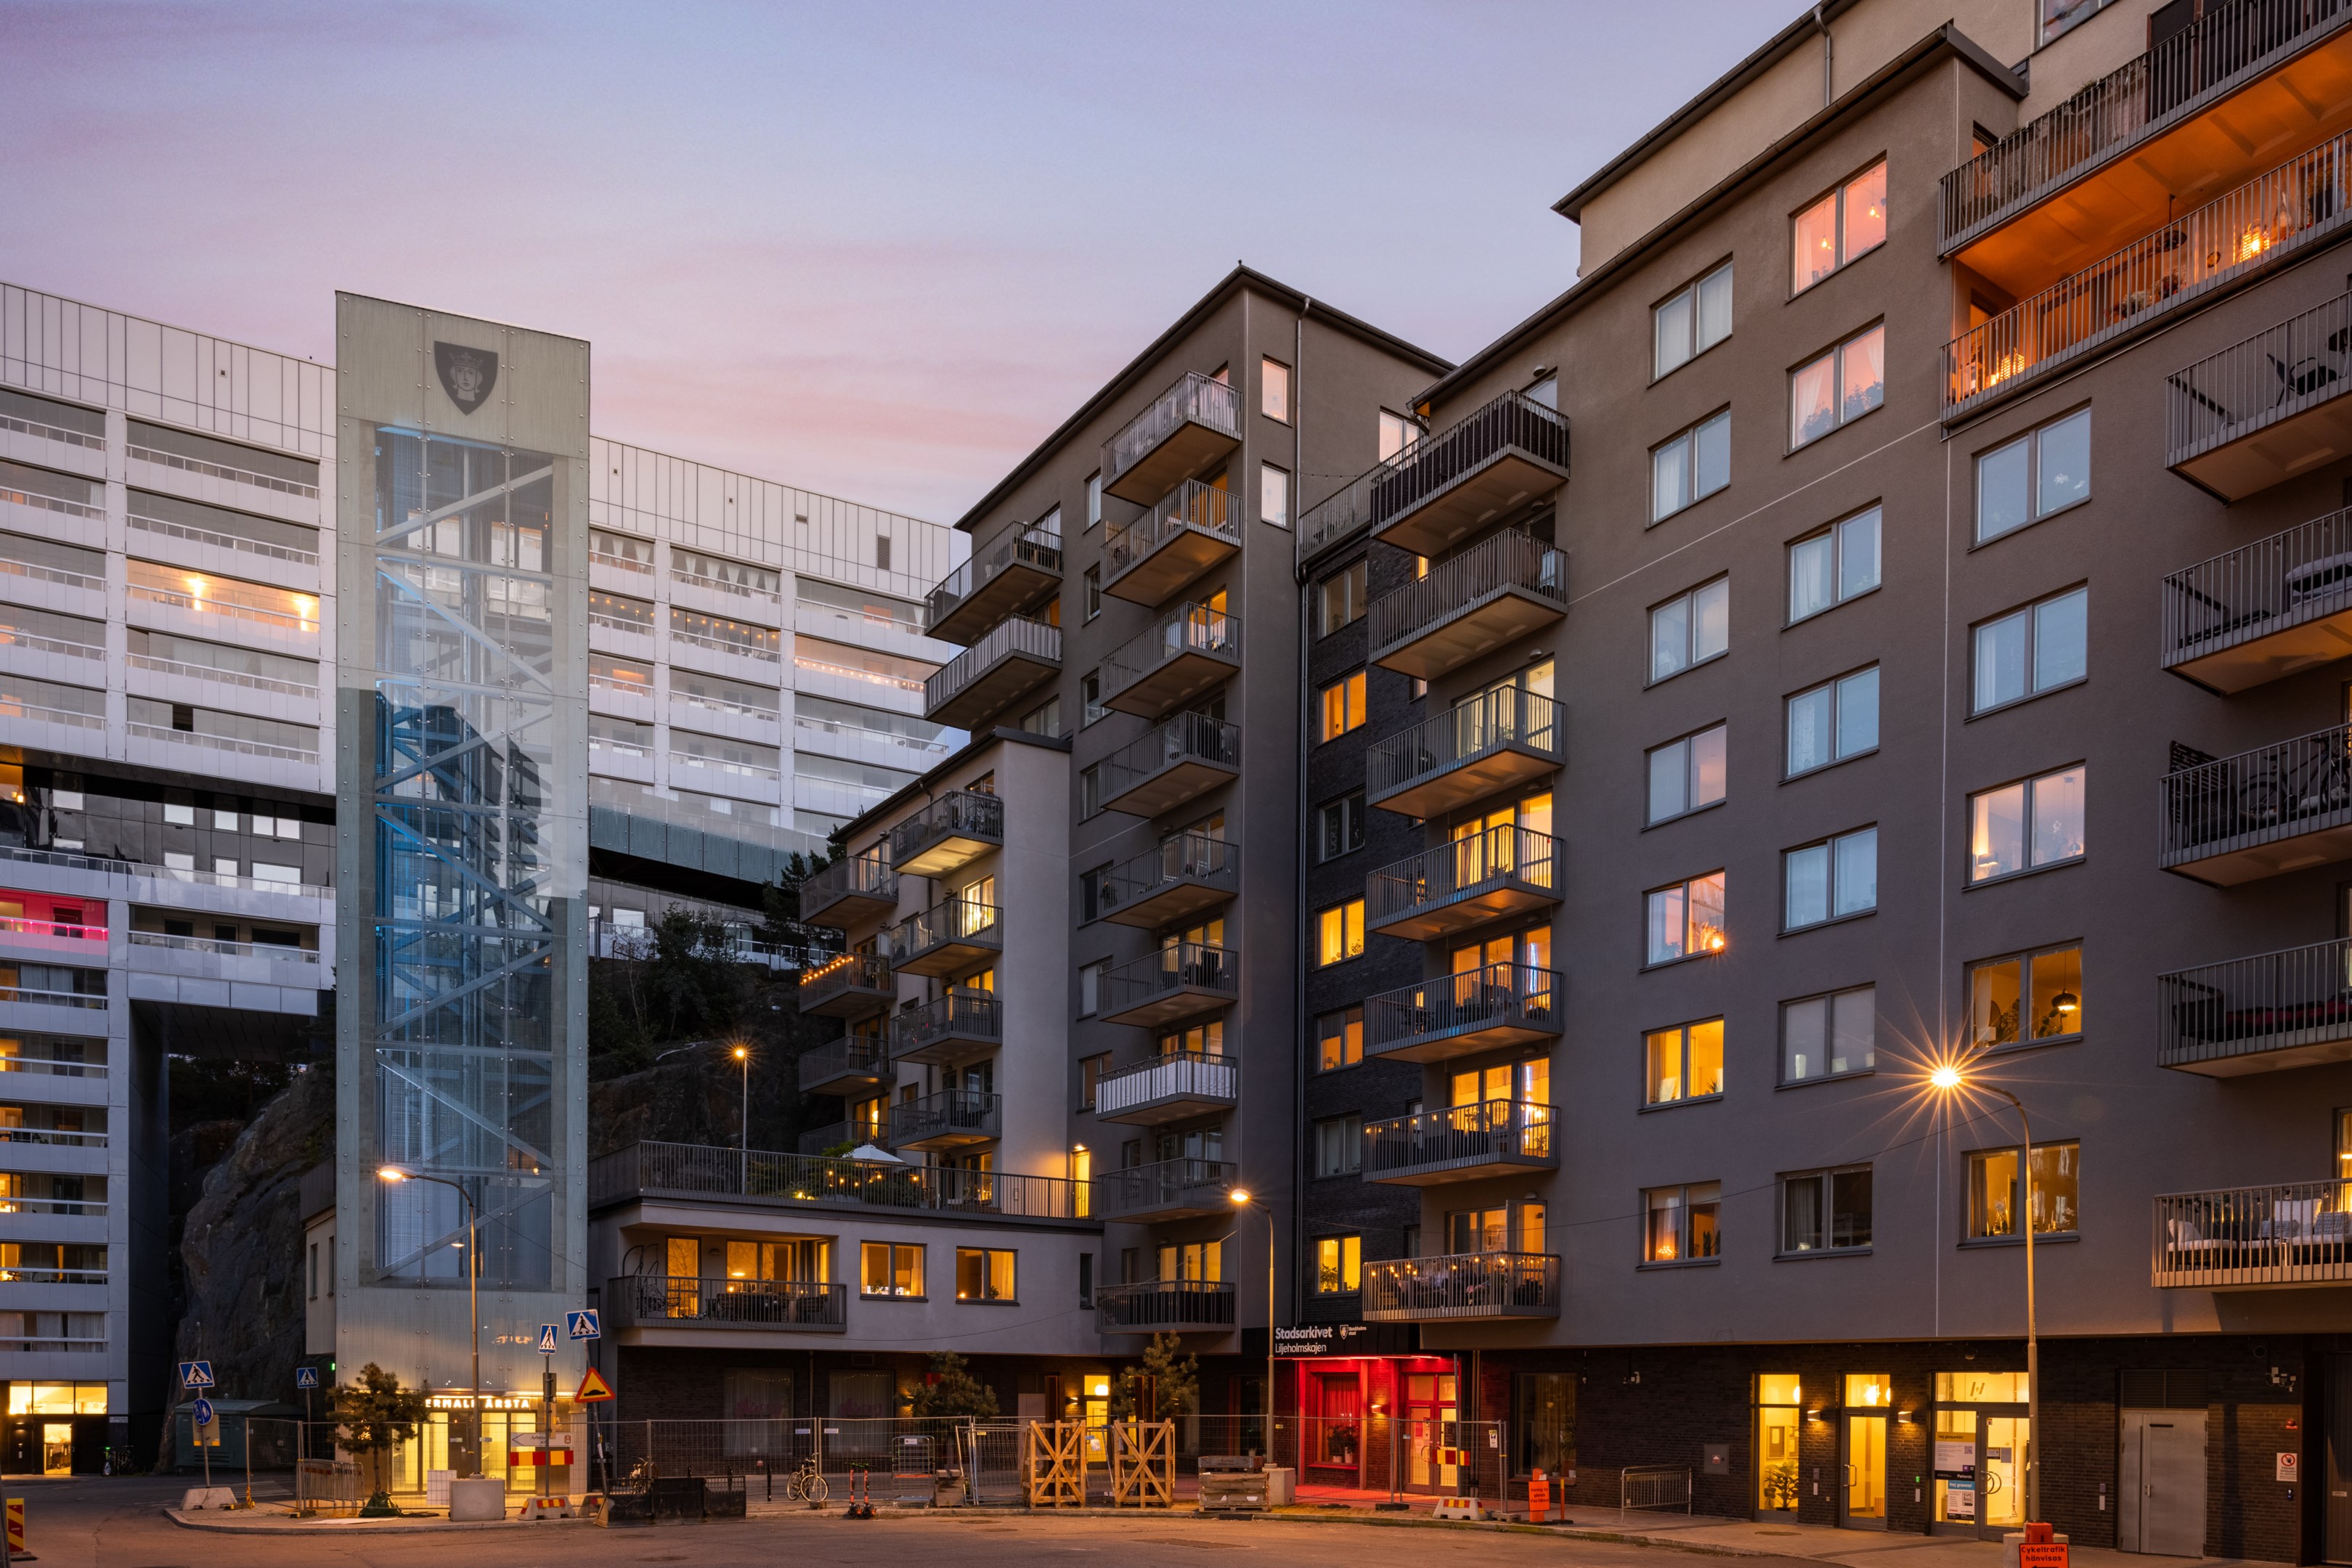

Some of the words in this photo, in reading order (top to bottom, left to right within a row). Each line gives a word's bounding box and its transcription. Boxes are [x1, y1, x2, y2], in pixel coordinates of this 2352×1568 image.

[1275, 1326, 1332, 1339] Stadsarkivet
[1275, 1342, 1327, 1355] Liljeholmskajen
[484, 1398, 530, 1408] ÅRSTA
